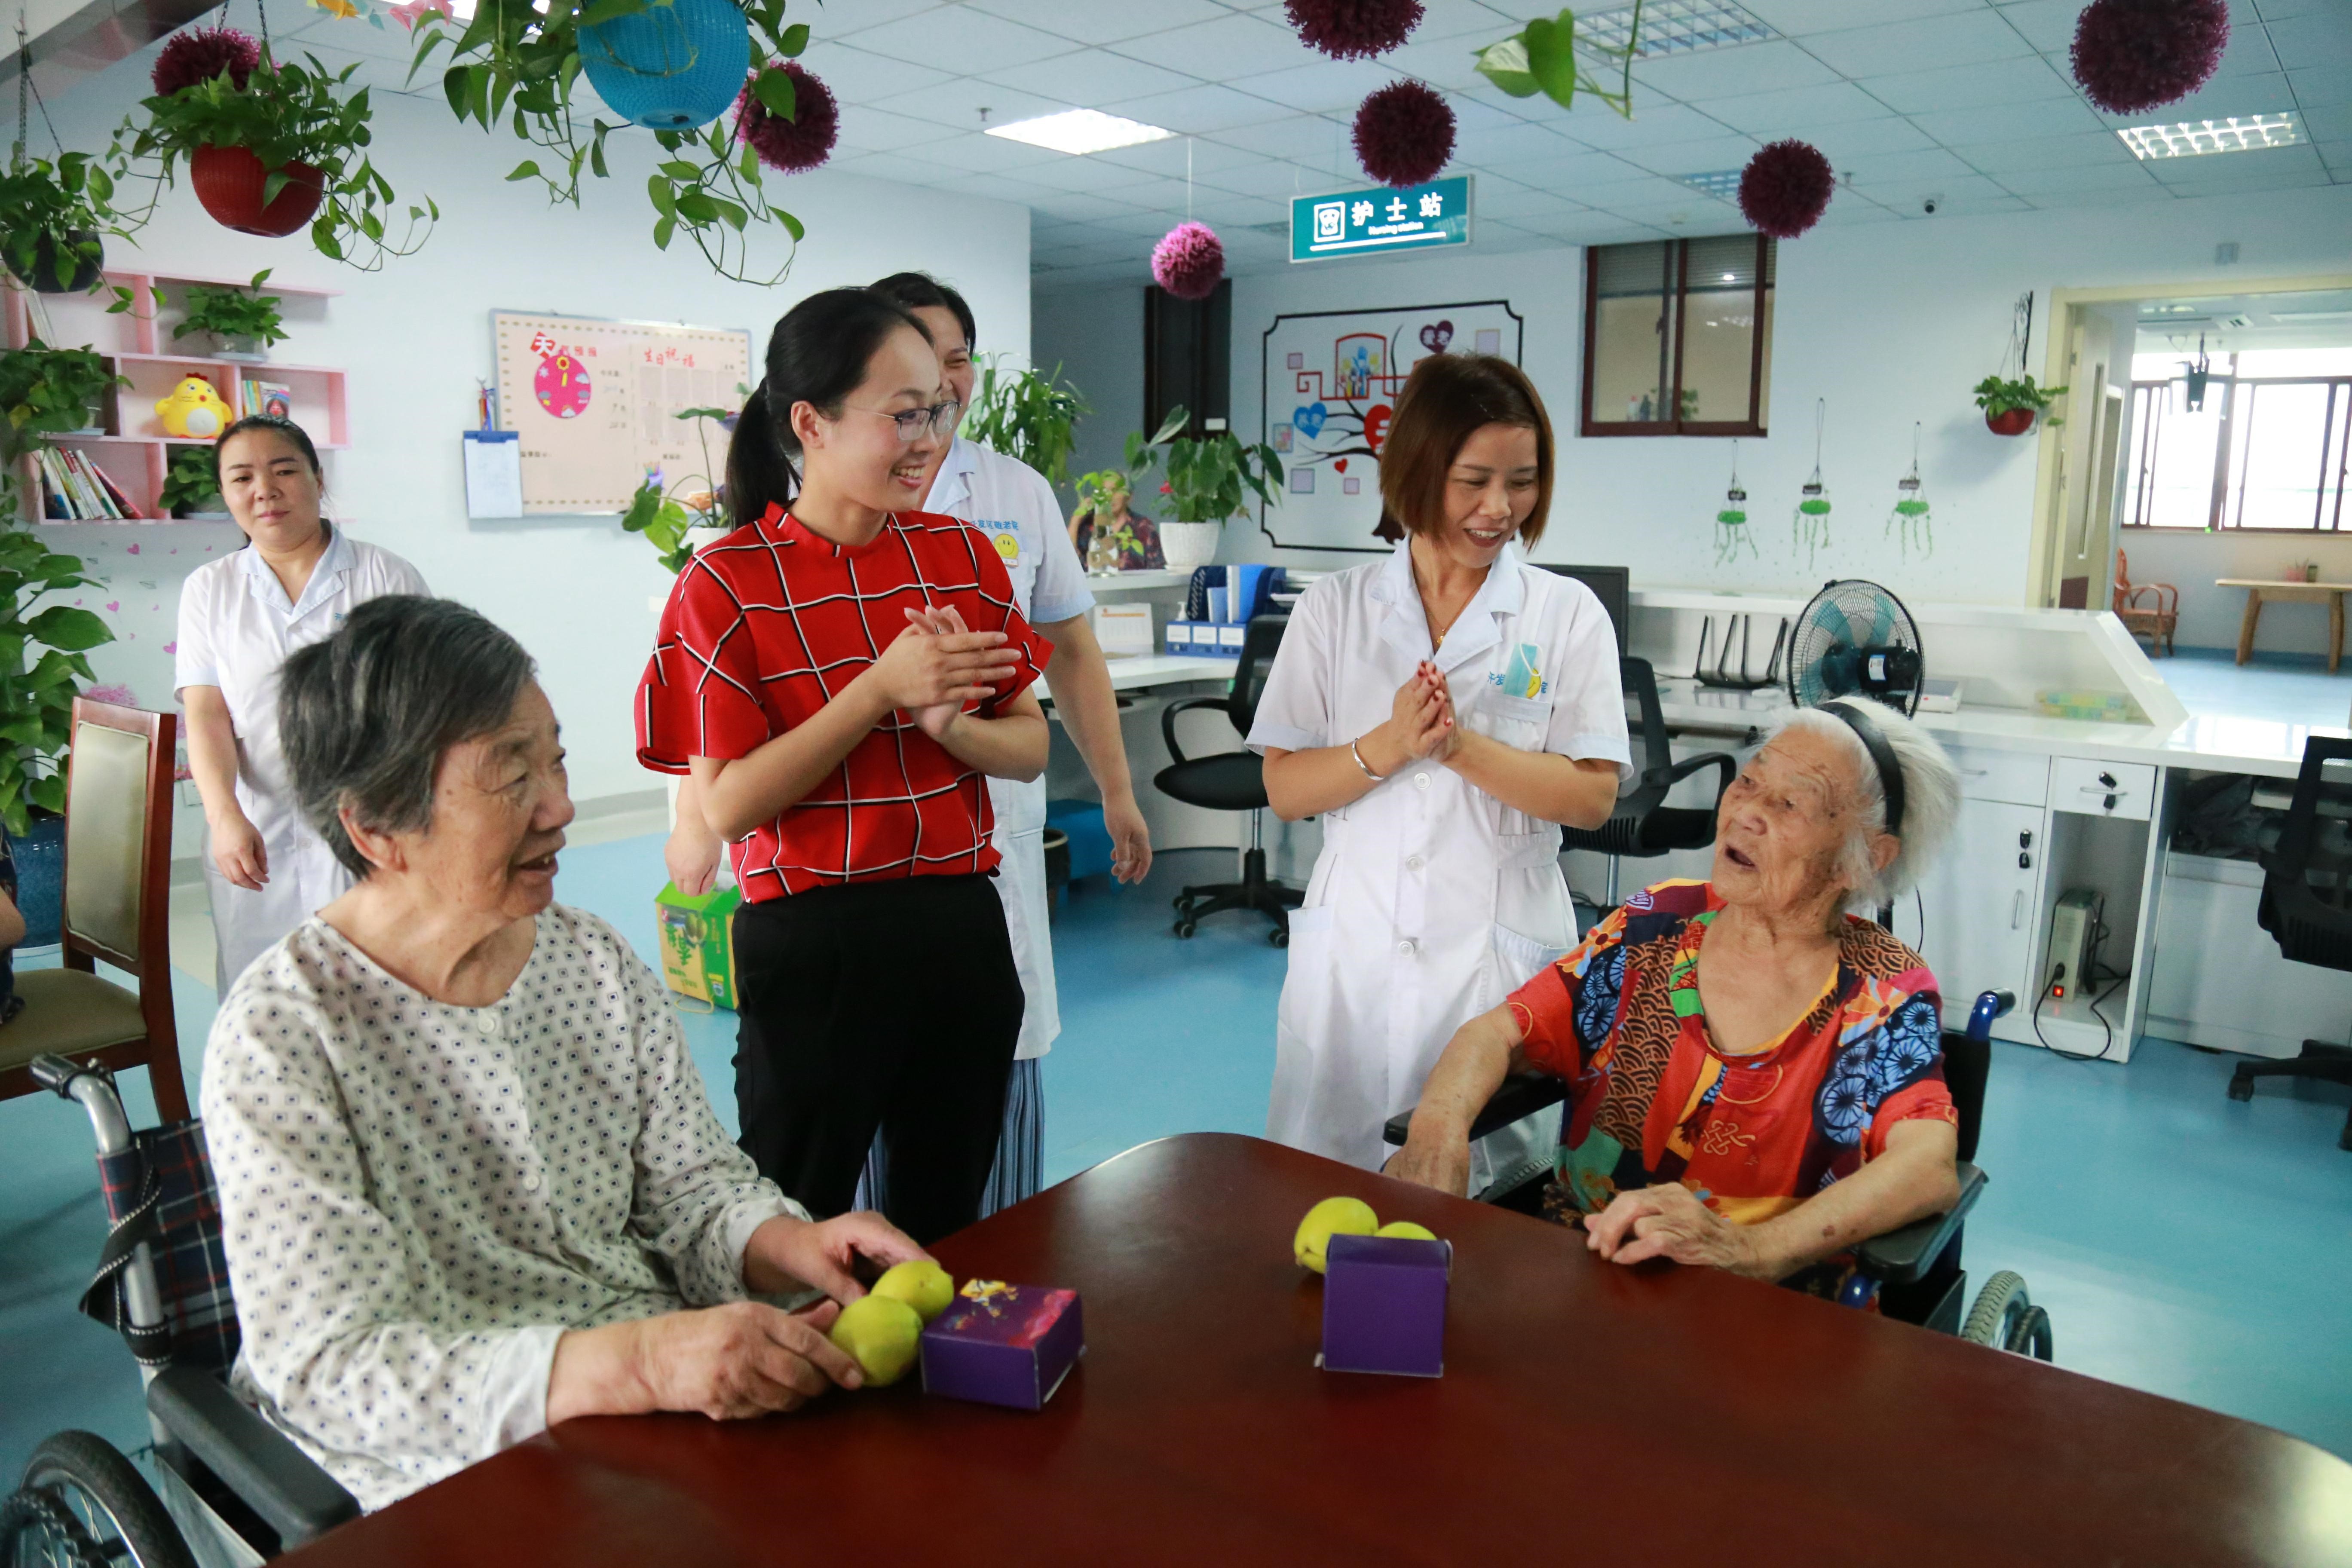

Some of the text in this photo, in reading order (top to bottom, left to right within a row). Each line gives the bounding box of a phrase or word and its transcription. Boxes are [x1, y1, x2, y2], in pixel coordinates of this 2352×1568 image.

[1352, 192, 1442, 226] 护士站
[644, 346, 695, 368] 生日祝福
